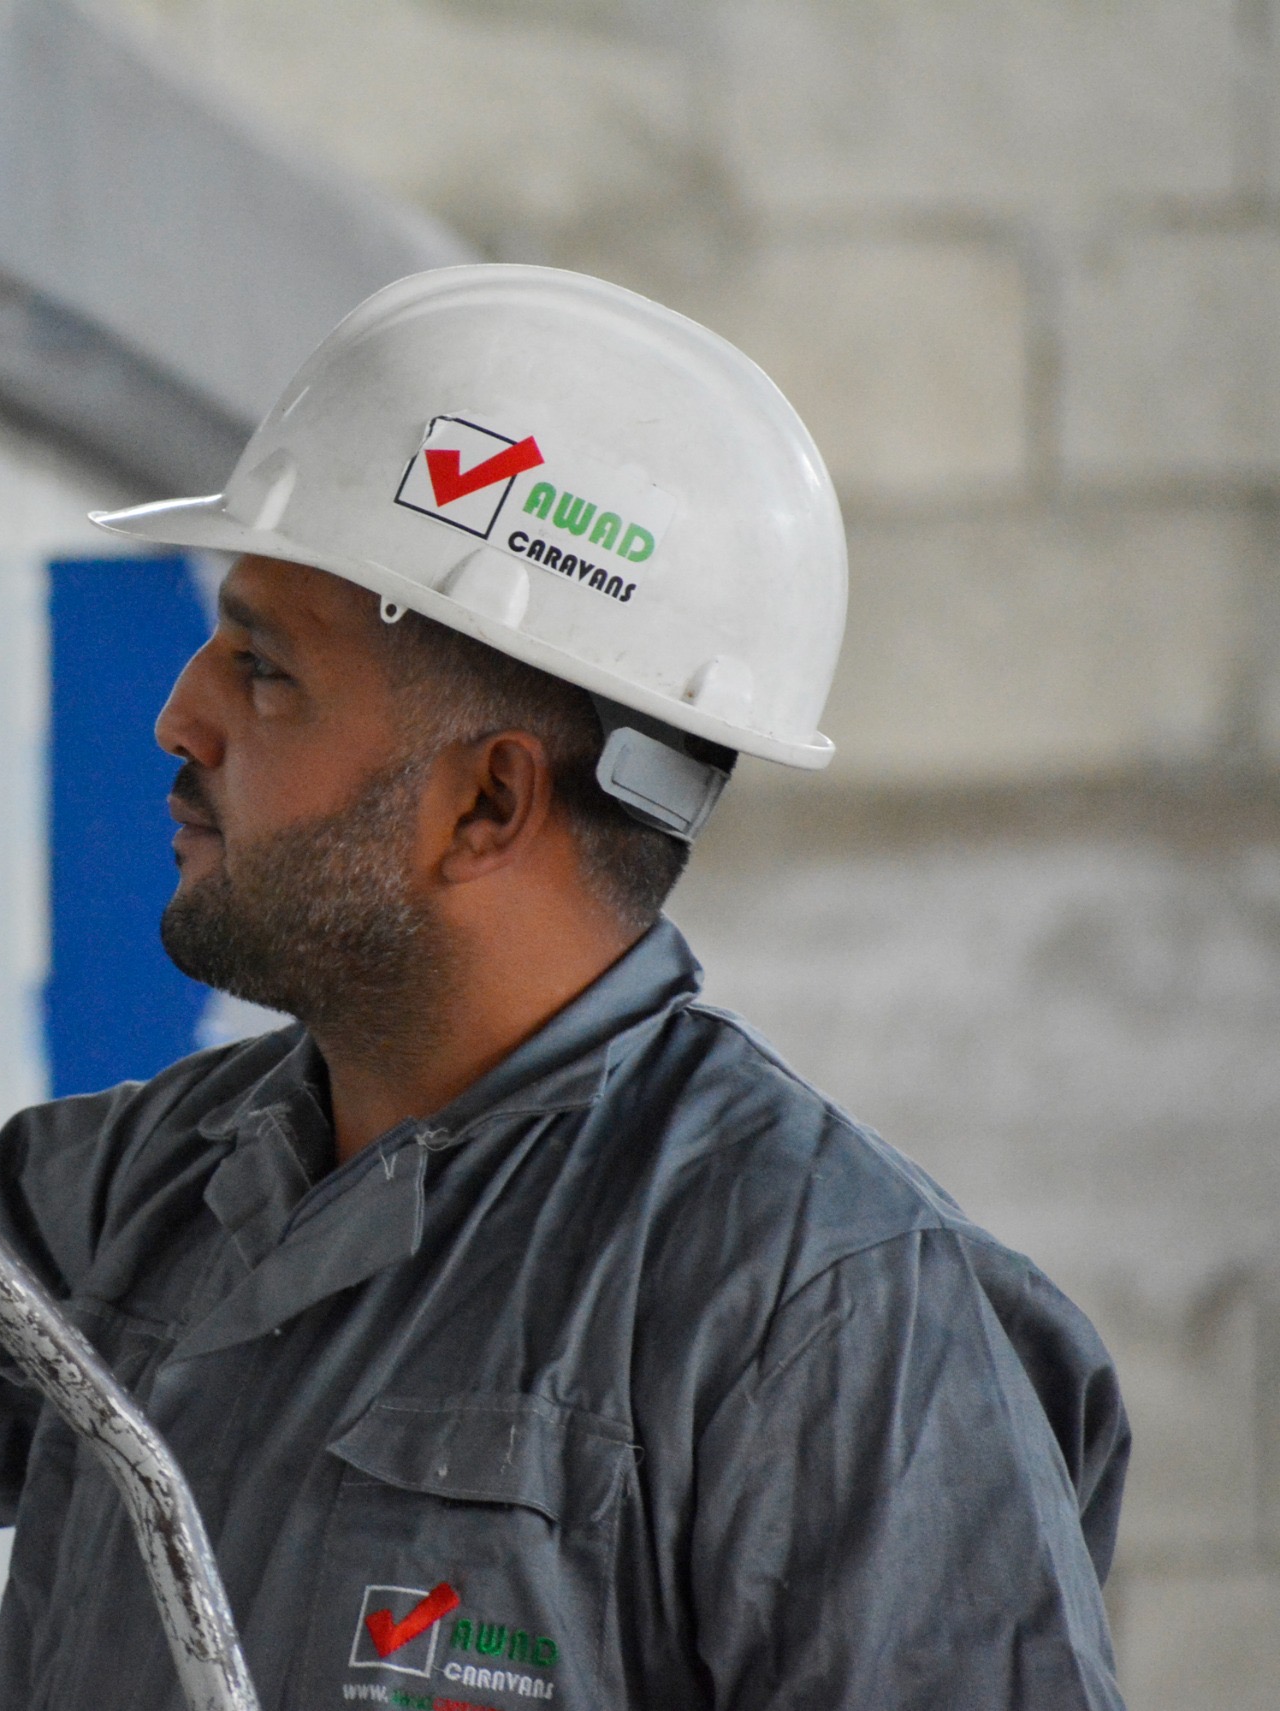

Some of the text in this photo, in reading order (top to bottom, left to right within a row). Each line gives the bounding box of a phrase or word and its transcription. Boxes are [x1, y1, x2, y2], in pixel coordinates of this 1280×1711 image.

[522, 481, 655, 562] AWAD
[508, 531, 637, 602] CARAVANS
[450, 1618, 559, 1666] AWAD
[443, 1662, 554, 1699] CARAVANS
